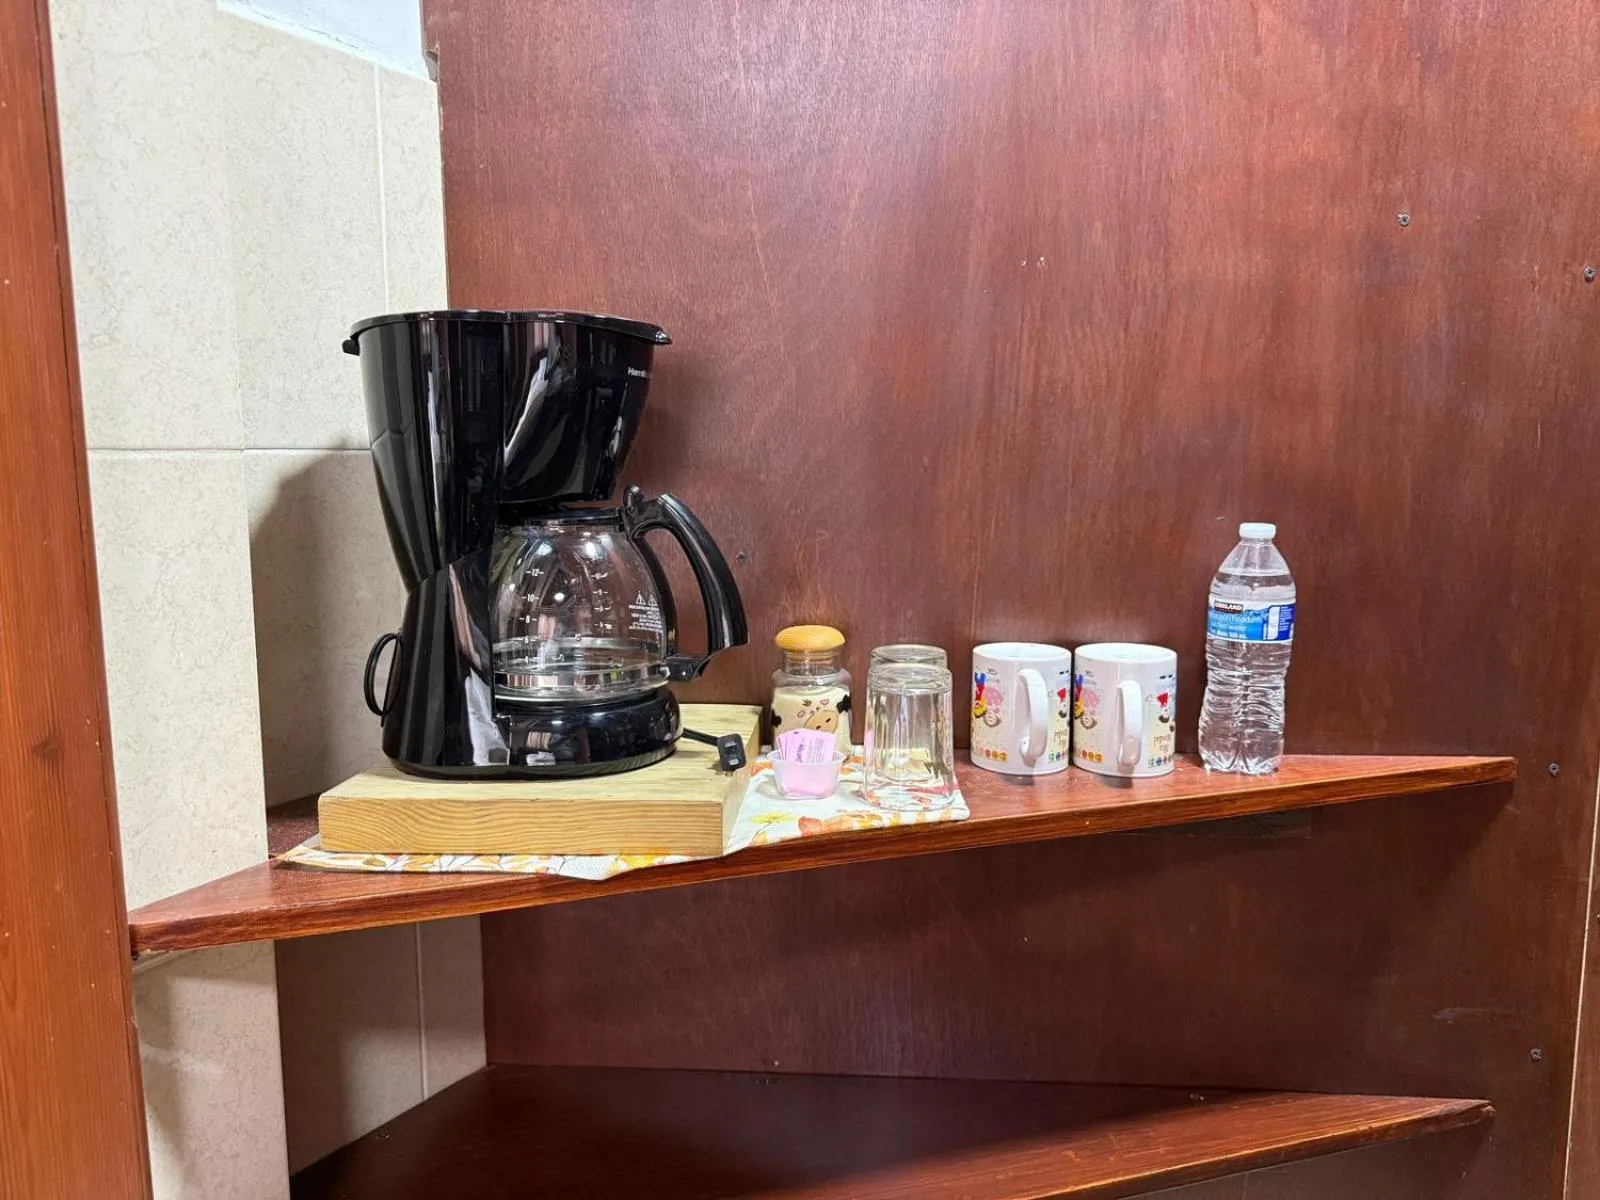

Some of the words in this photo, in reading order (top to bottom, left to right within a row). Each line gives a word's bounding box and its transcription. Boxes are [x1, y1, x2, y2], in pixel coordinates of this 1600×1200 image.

[531, 568, 540, 577] 12
[527, 594, 536, 602] 10
[525, 615, 531, 624] 8
